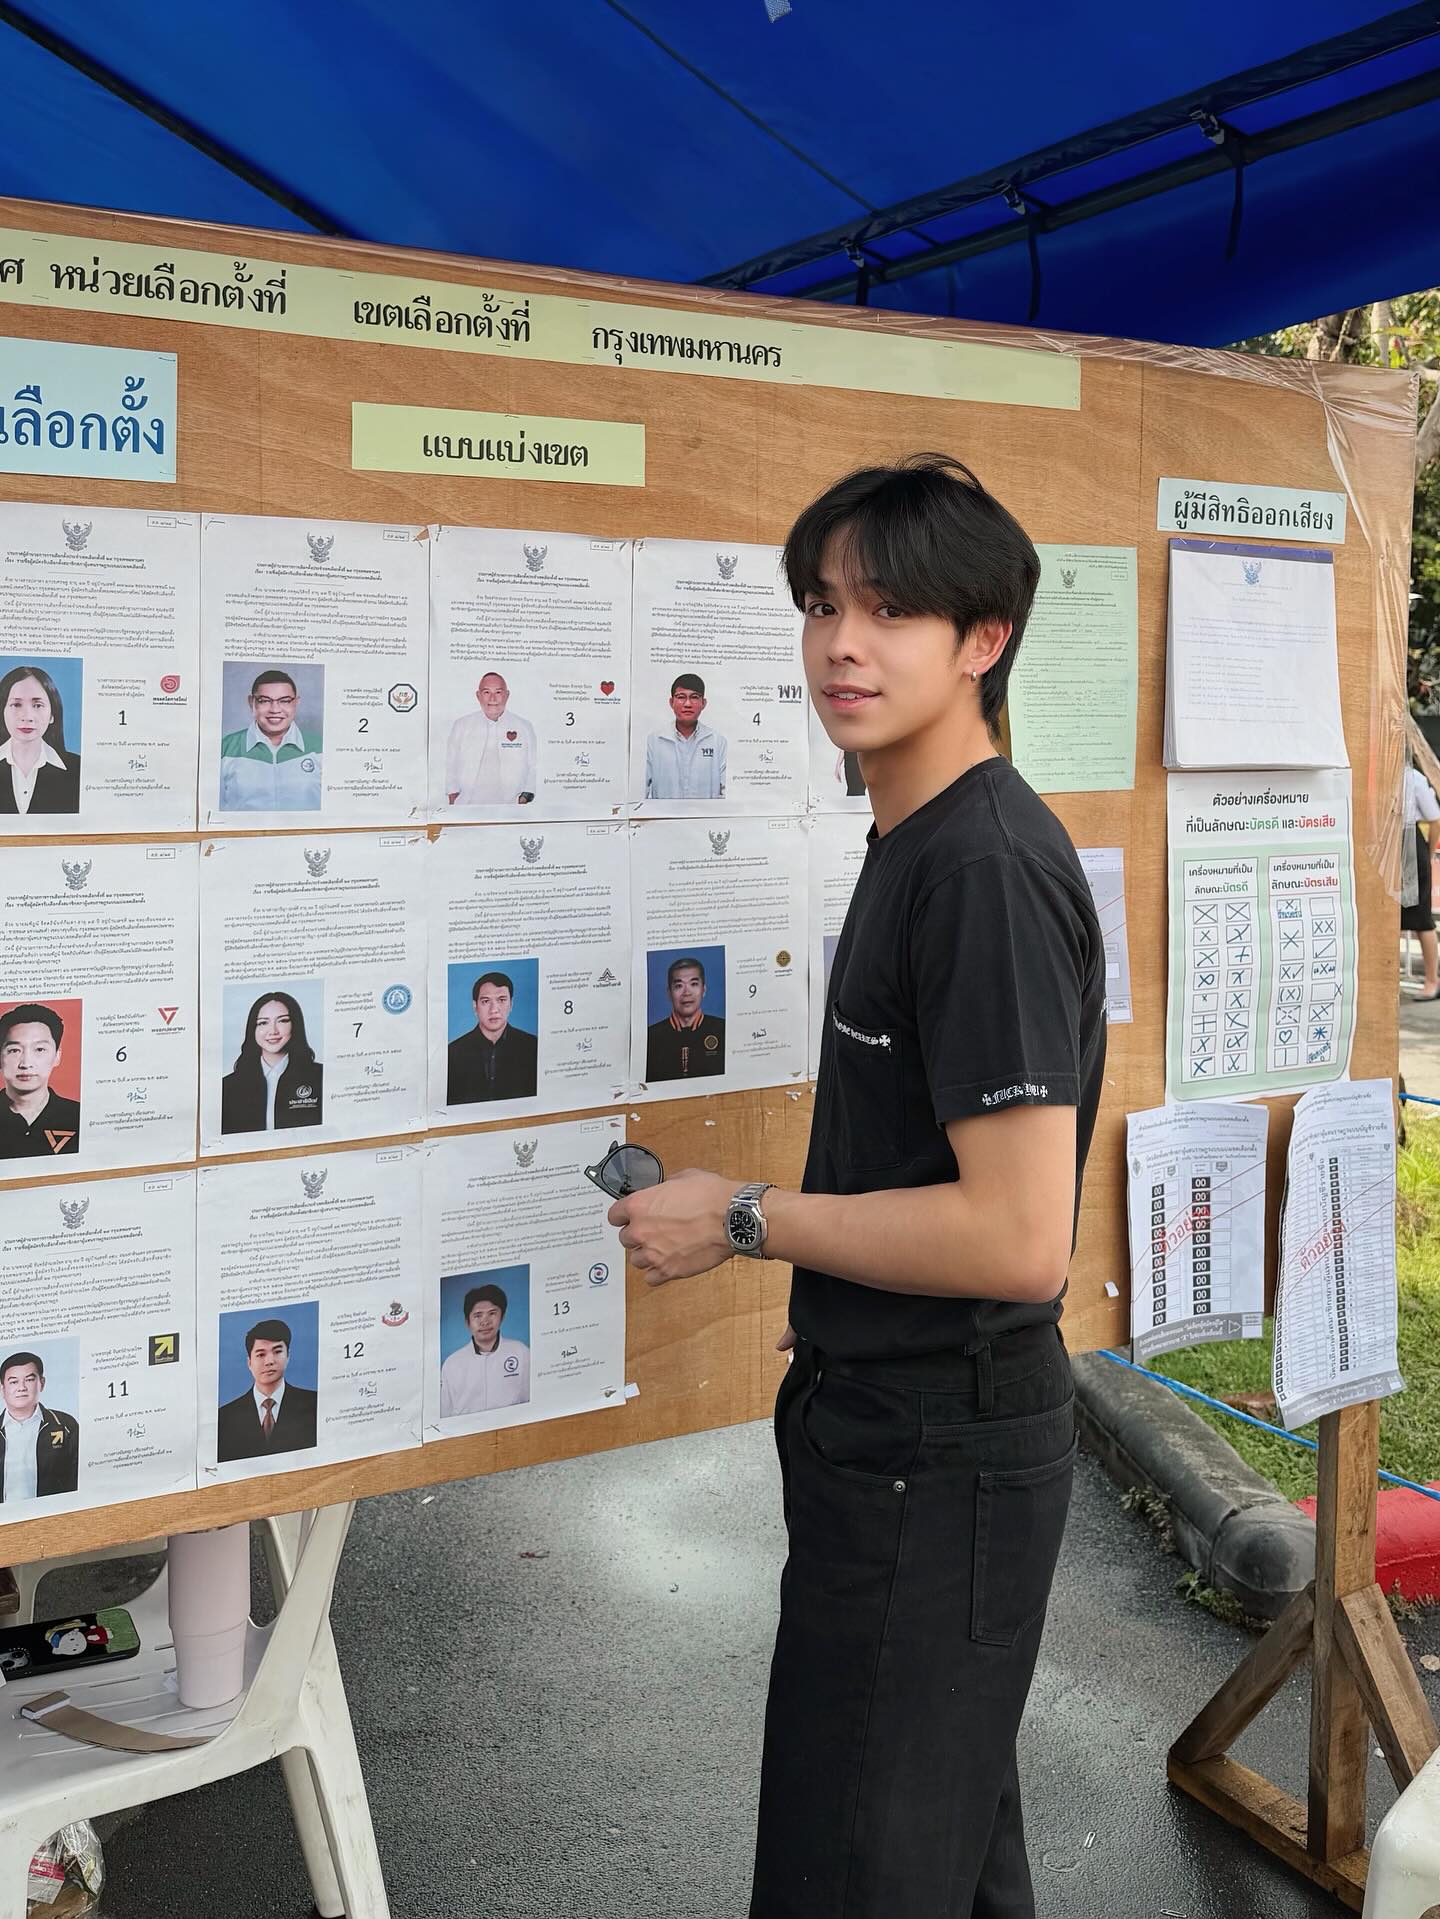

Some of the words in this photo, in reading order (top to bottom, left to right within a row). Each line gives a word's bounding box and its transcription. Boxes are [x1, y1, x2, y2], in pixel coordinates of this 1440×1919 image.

[50, 256, 288, 316] หน่วยเลือกตั้งที่
[352, 293, 532, 343] เขตเลือกตั้งที่
[591, 324, 782, 368] กรุงเทพมหานคร
[421, 433, 589, 468] แบบแบ่งเขต
[1174, 490, 1334, 531] ผู้มีสิทธิออกเสียง
[777, 684, 802, 699] พท
[118, 709, 128, 726] 1
[565, 711, 576, 727] 3
[752, 712, 761, 727] 4
[357, 718, 369, 734] 2
[1212, 787, 1309, 807] ตัวอย่างเครื่องหมาย
[1185, 815, 1280, 834] ที่เป็นลักษณะบัตรดี
[1282, 813, 1336, 830] และบัตรเสีย
[1188, 862, 1253, 877] เครื่องหมายที่เป็น
[1273, 858, 1335, 873] เครื่องหมายที่เป็น
[1194, 880, 1249, 895] ลักษณะบัตรดี
[1271, 875, 1339, 891] ลักษณะบัตรเสีย
[749, 984, 757, 999] 9
[564, 1000, 574, 1015] 8
[352, 1022, 363, 1038] 7
[115, 1046, 127, 1063] 6
[1196, 1178, 1206, 1187] 00
[1153, 1186, 1162, 1196] 00
[1196, 1192, 1206, 1201] 00
[1154, 1200, 1162, 1210] 00
[1154, 1215, 1162, 1224] 00
[1196, 1234, 1206, 1243] 00
[1196, 1248, 1206, 1257] 00
[1155, 1257, 1163, 1266] 00
[1196, 1262, 1206, 1271] 00
[1155, 1272, 1163, 1281] 00
[1196, 1276, 1206, 1285] 00
[1155, 1286, 1163, 1295] 00
[1196, 1290, 1206, 1299] 00
[553, 1300, 571, 1316] 13
[1155, 1300, 1164, 1310] 00
[1197, 1304, 1207, 1313] 00
[1155, 1314, 1164, 1324] 00
[343, 1342, 364, 1360] 12
[107, 1380, 129, 1399] 11
